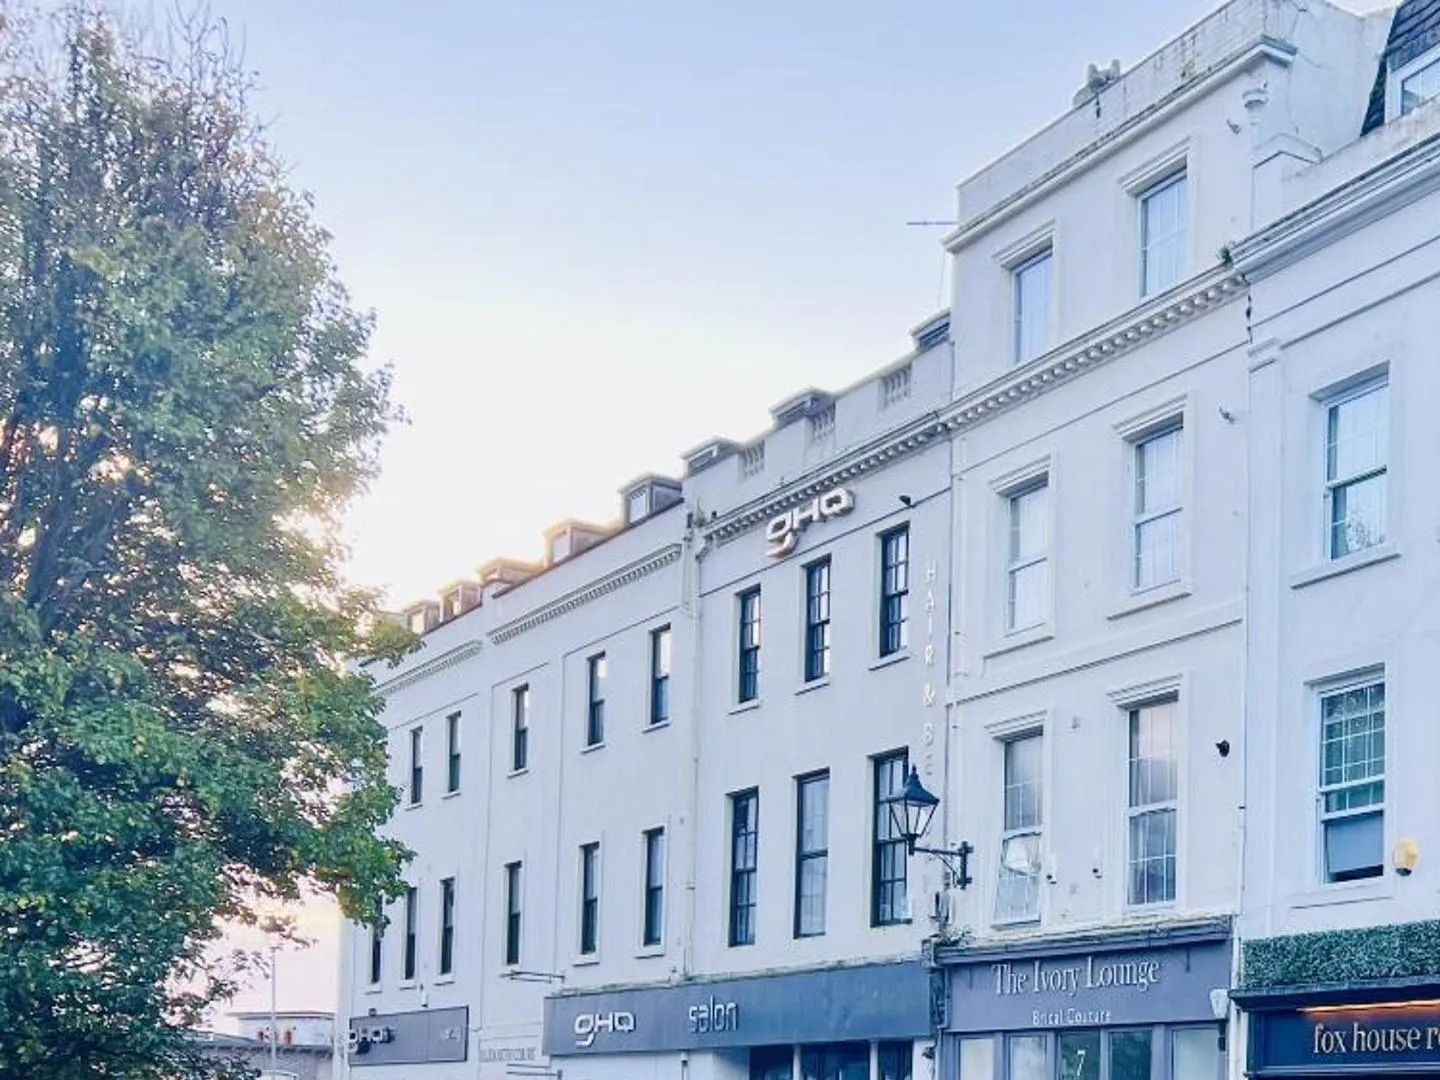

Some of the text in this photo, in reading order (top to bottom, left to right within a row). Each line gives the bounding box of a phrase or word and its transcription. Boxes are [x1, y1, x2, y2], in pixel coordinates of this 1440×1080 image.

[993, 955, 1161, 996] The Ivory Lounge
[689, 996, 738, 1034] salon
[1313, 1023, 1347, 1054] fox
[1351, 1021, 1421, 1052] house
[1076, 1049, 1086, 1077] 7
